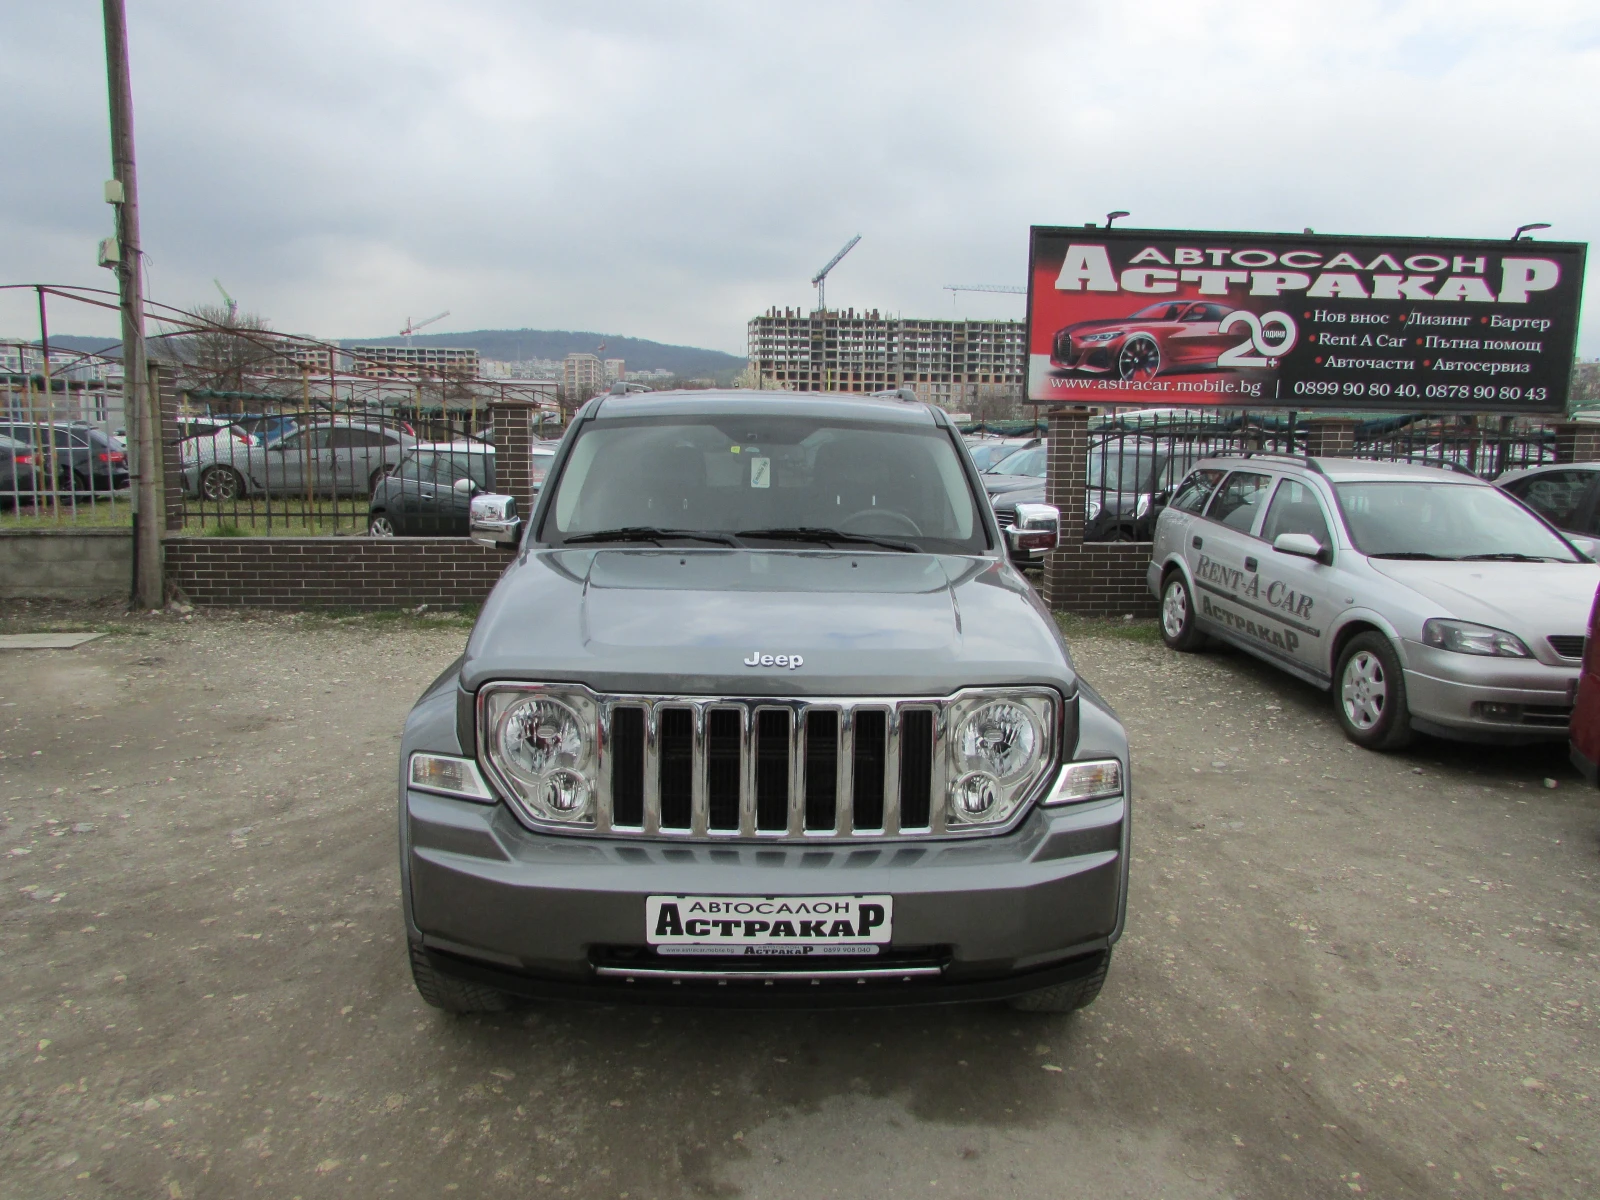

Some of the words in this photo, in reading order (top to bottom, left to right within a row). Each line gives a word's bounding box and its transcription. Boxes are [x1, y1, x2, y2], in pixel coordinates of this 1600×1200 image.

[1128, 247, 1486, 273] АВТОСАЛОН
[1313, 309, 1346, 324] Нов
[1350, 312, 1390, 325] внос
[1407, 312, 1472, 328] Лизинг
[1490, 315, 1551, 333] Бартер
[1318, 332, 1357, 346] Rent
[1359, 333, 1374, 347] A
[1376, 334, 1407, 348] Car
[1425, 335, 1480, 350] Пътна
[1483, 338, 1541, 353] помощ
[1324, 355, 1415, 370] Авточасти
[1432, 358, 1531, 375] Автосервиз
[1050, 377, 1261, 397] www.astracar.mobile.bg
[1294, 381, 1339, 395] 0899
[1342, 382, 1365, 396] 90
[1368, 383, 1391, 397] 80
[1394, 384, 1421, 399] 40,
[1425, 384, 1470, 399] 0878
[1473, 386, 1496, 399] 90
[1499, 386, 1521, 400] 80
[1524, 387, 1547, 400] 43
[744, 651, 804, 670] Jeep
[688, 901, 850, 914] АВТОСАЛОН
